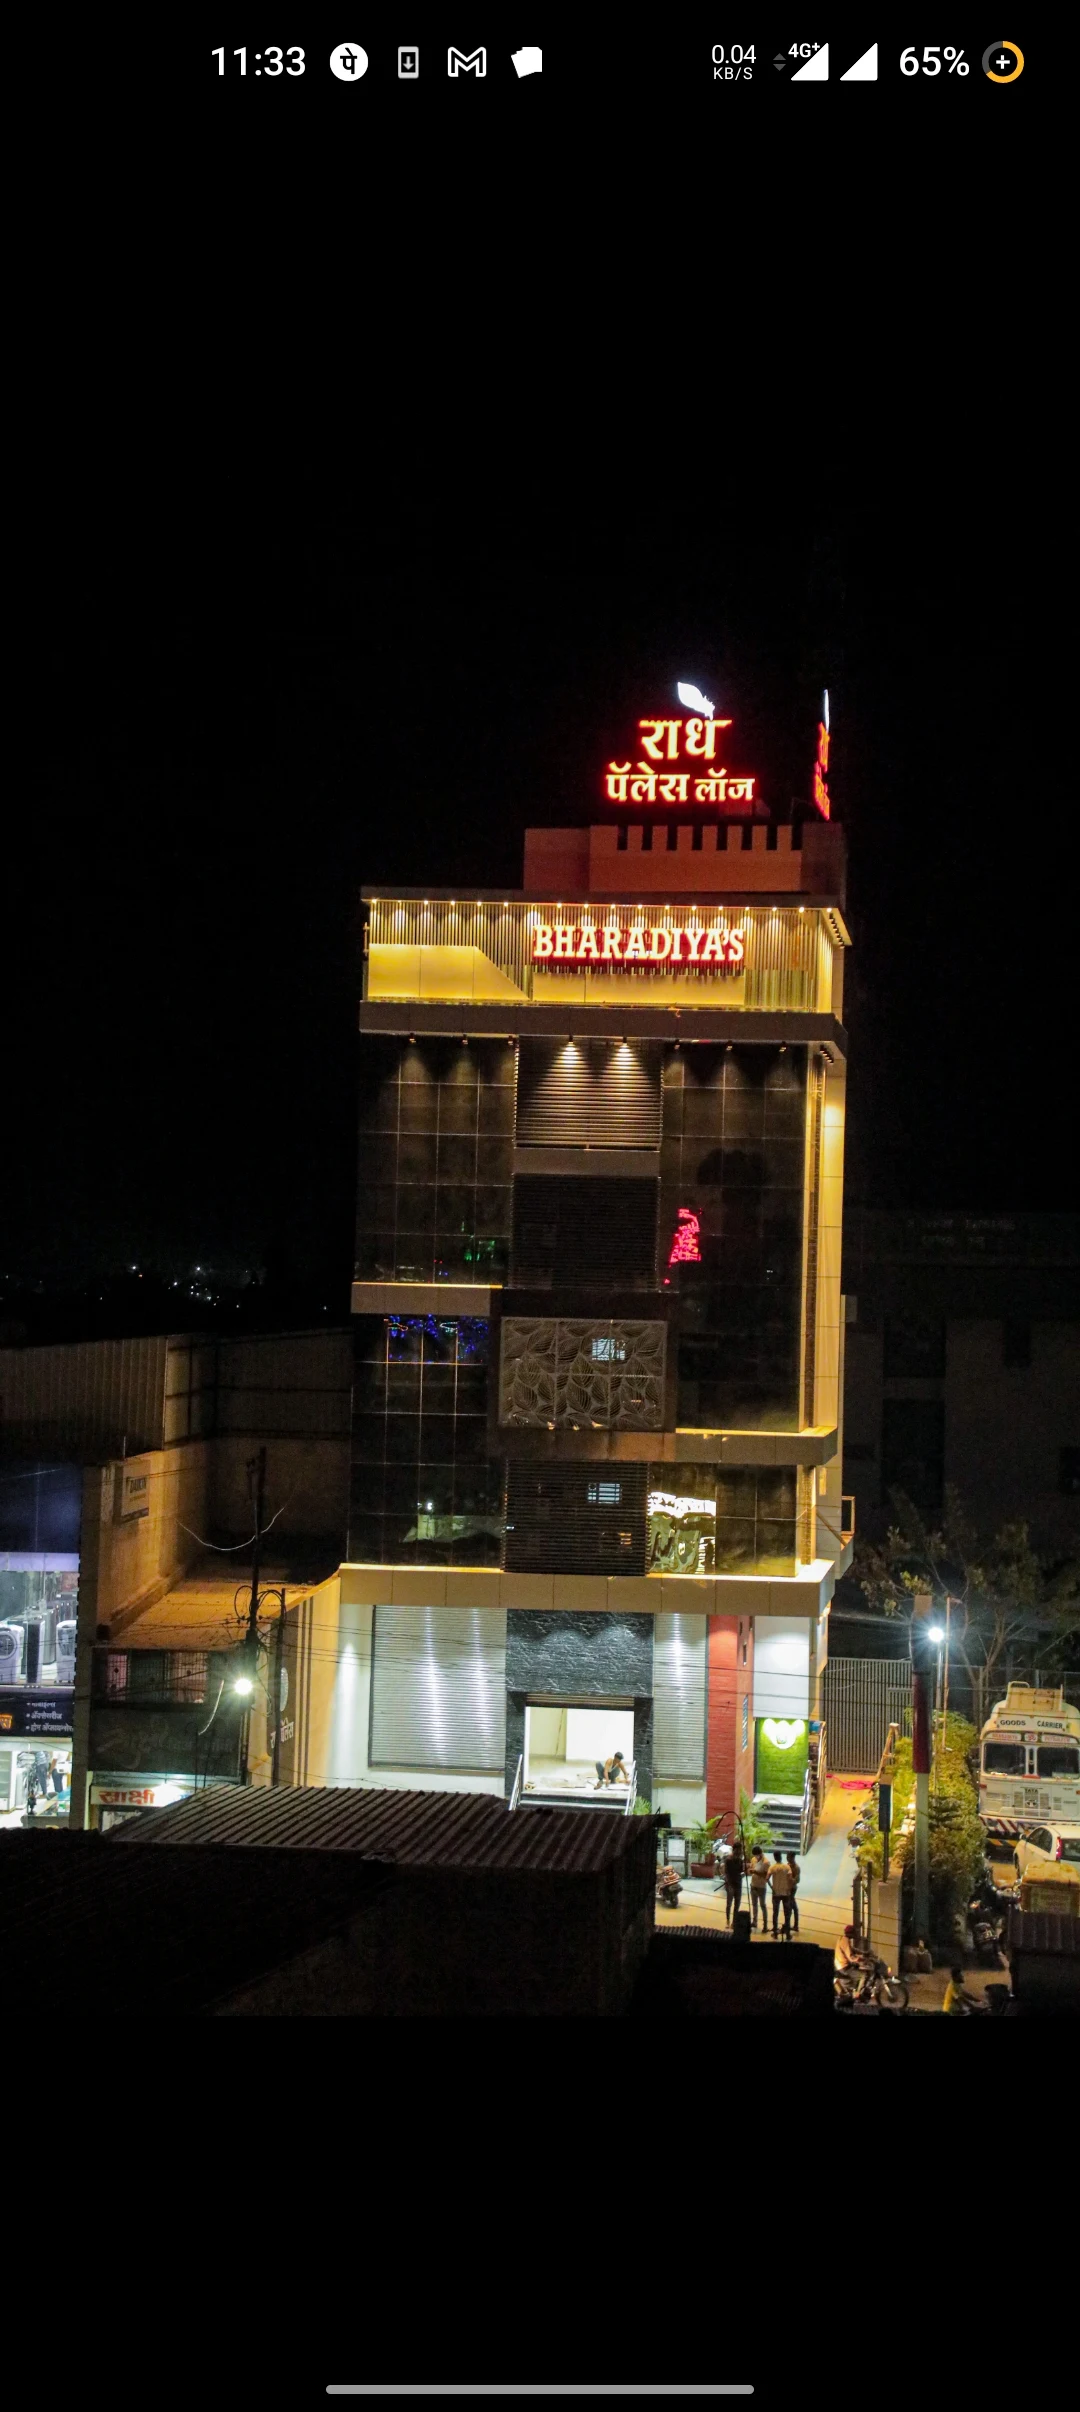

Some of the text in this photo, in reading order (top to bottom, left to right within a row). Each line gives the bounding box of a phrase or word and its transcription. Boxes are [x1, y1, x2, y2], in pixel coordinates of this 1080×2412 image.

[605, 761, 756, 802] पॅलेस लॉज
[532, 924, 744, 962] BHARADIYA'S
[1037, 1720, 1063, 1729] CARRIER
[98, 1788, 155, 1805] साक्षी
